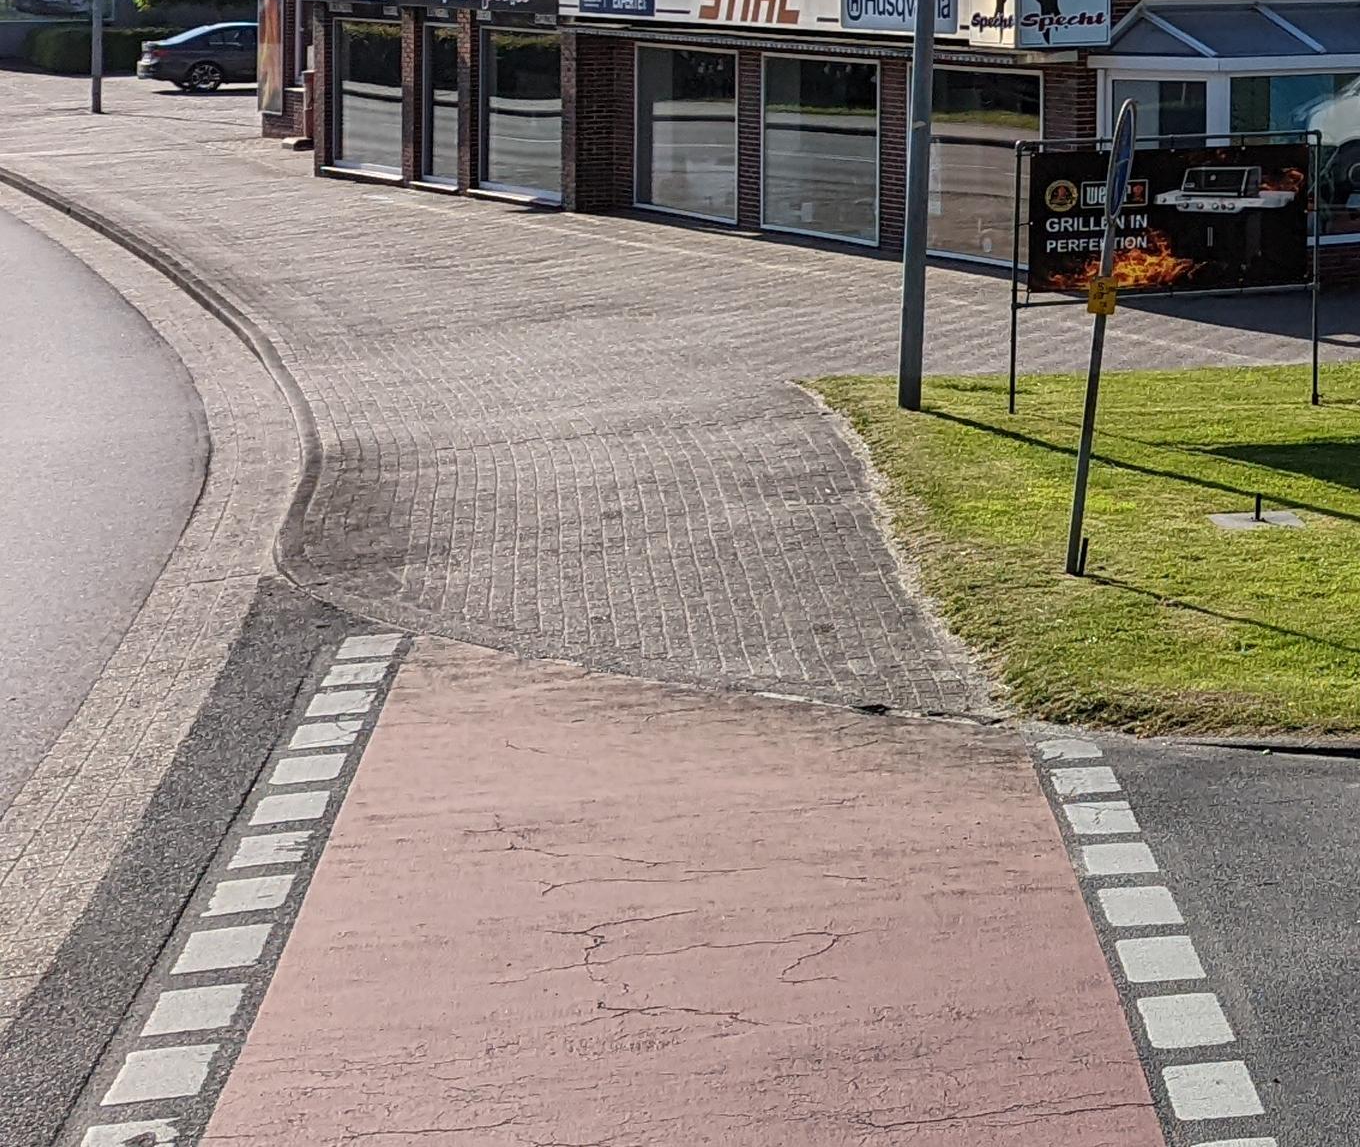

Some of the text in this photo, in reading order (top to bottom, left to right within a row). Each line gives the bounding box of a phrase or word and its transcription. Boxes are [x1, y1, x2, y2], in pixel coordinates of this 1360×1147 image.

[971, 11, 1015, 33] Specht
[1021, 11, 1106, 33] Specht
[1130, 214, 1148, 229] IN
